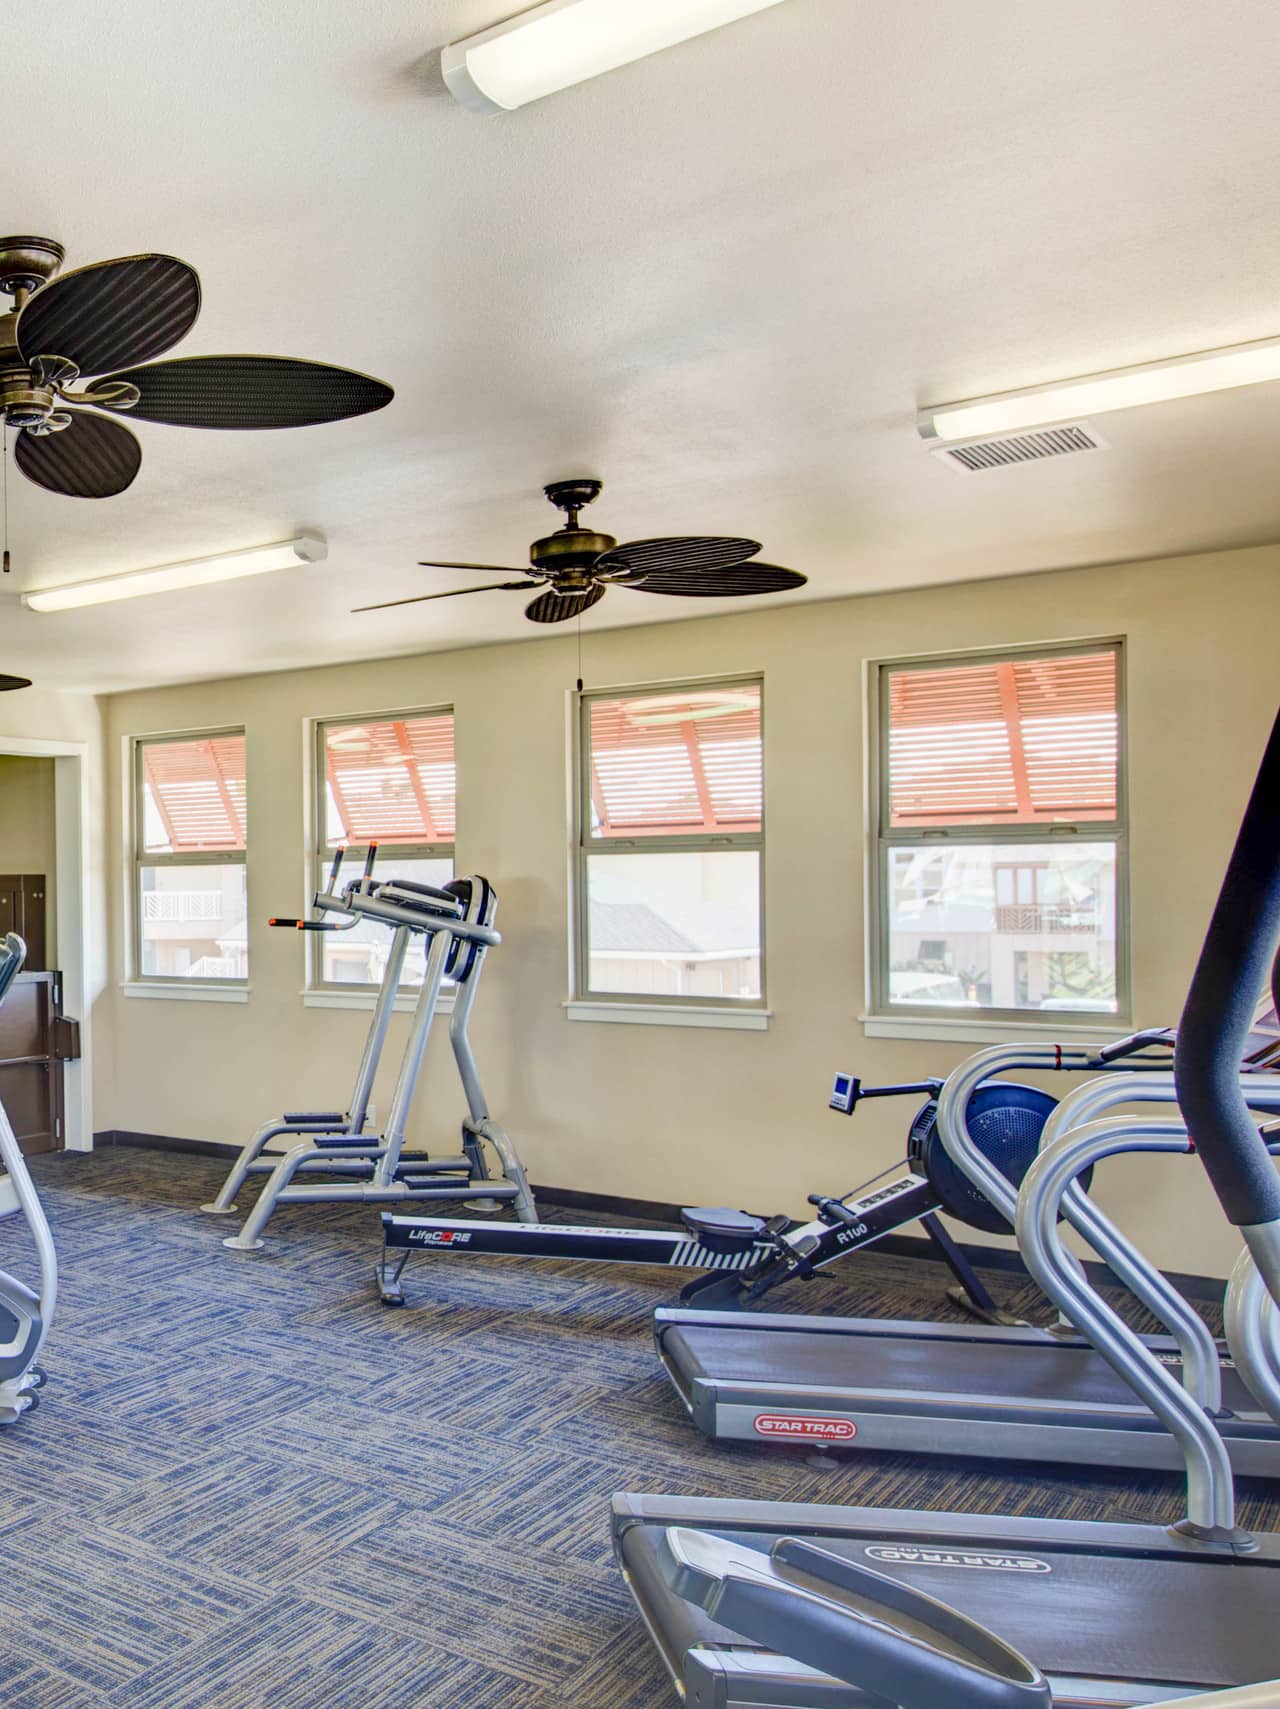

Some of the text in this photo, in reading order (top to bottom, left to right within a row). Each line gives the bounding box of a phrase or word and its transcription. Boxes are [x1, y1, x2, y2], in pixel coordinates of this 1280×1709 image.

[408, 1230, 472, 1242] LifeCORE
[760, 1421, 848, 1434] STAR TRAC
[881, 1551, 1039, 1569] STAR TRAC
